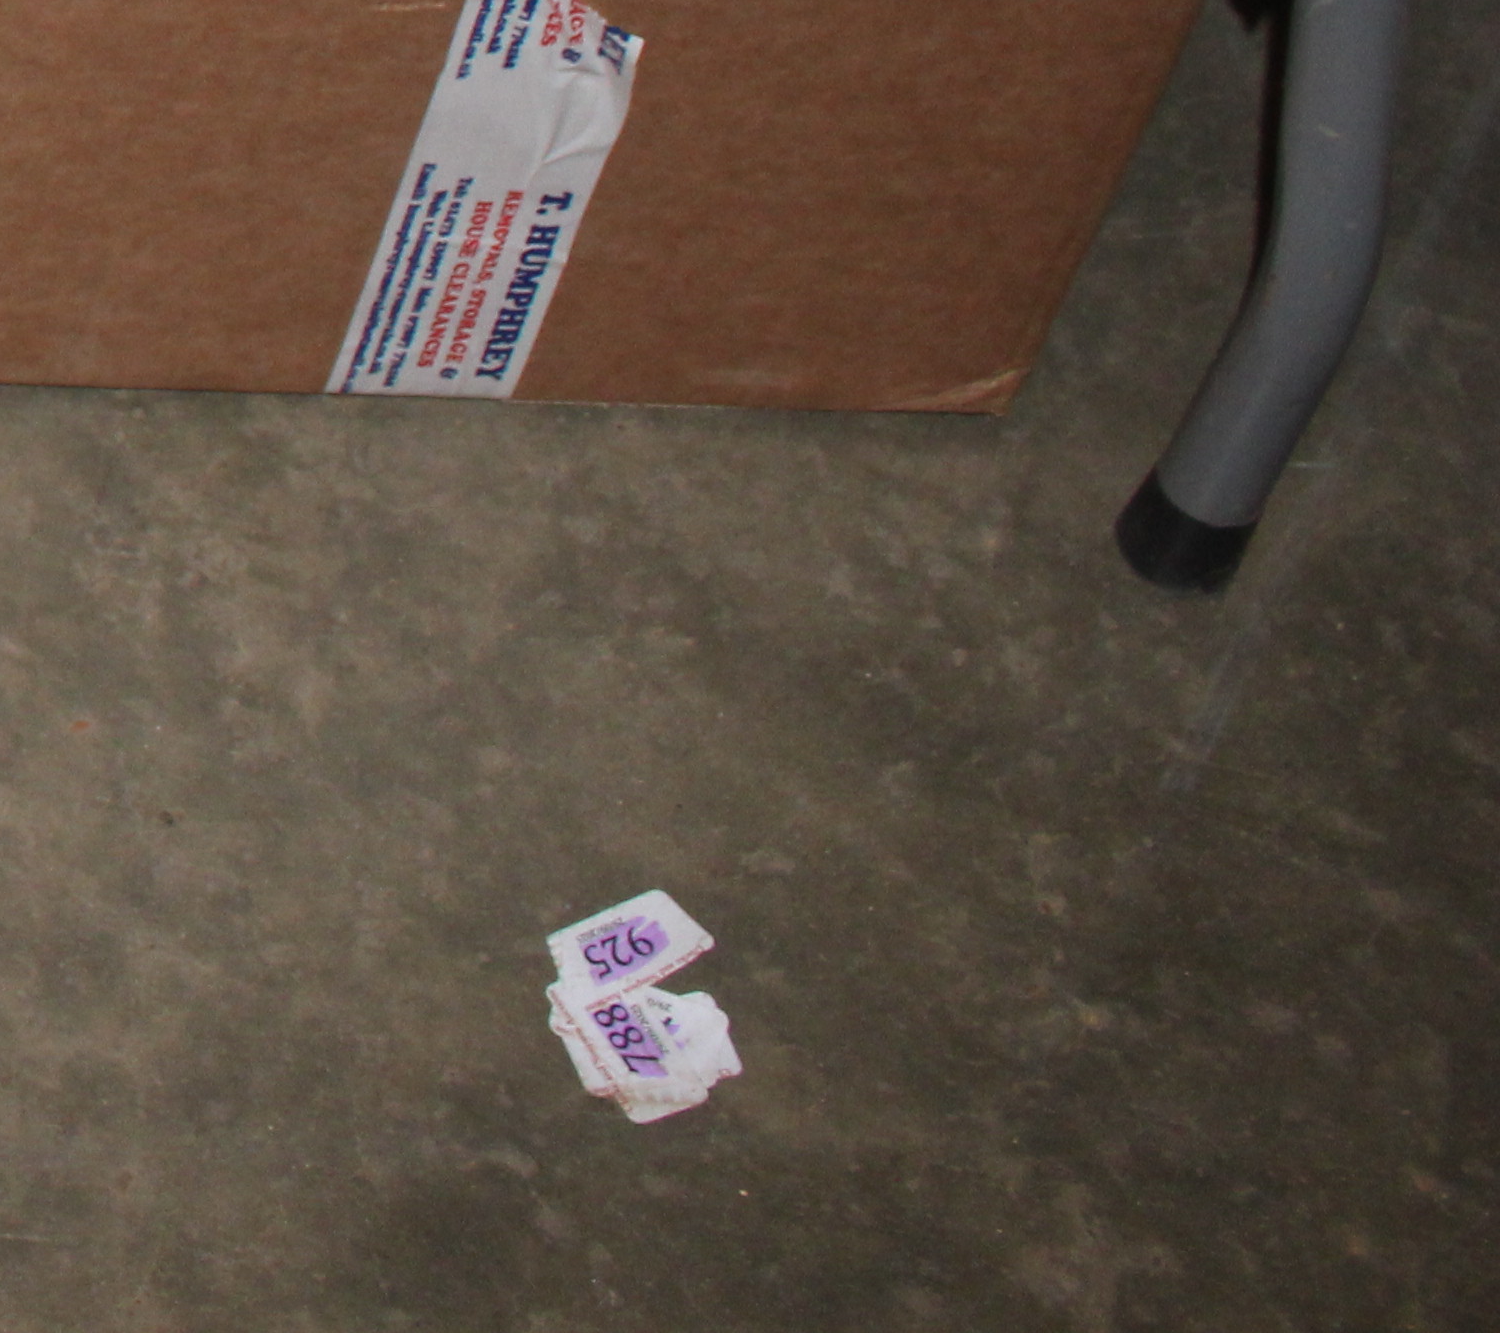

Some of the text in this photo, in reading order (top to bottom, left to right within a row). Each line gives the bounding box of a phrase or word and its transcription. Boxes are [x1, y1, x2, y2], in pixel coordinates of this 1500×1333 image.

[460, 200, 493, 258] HOUSE
[416, 261, 468, 368] CLEARANCES
[452, 189, 524, 365] REMOVALS, STORAGE
[475, 190, 574, 382] T. HUMPHREY
[583, 925, 655, 980] 925
[593, 1002, 660, 1075] 788
